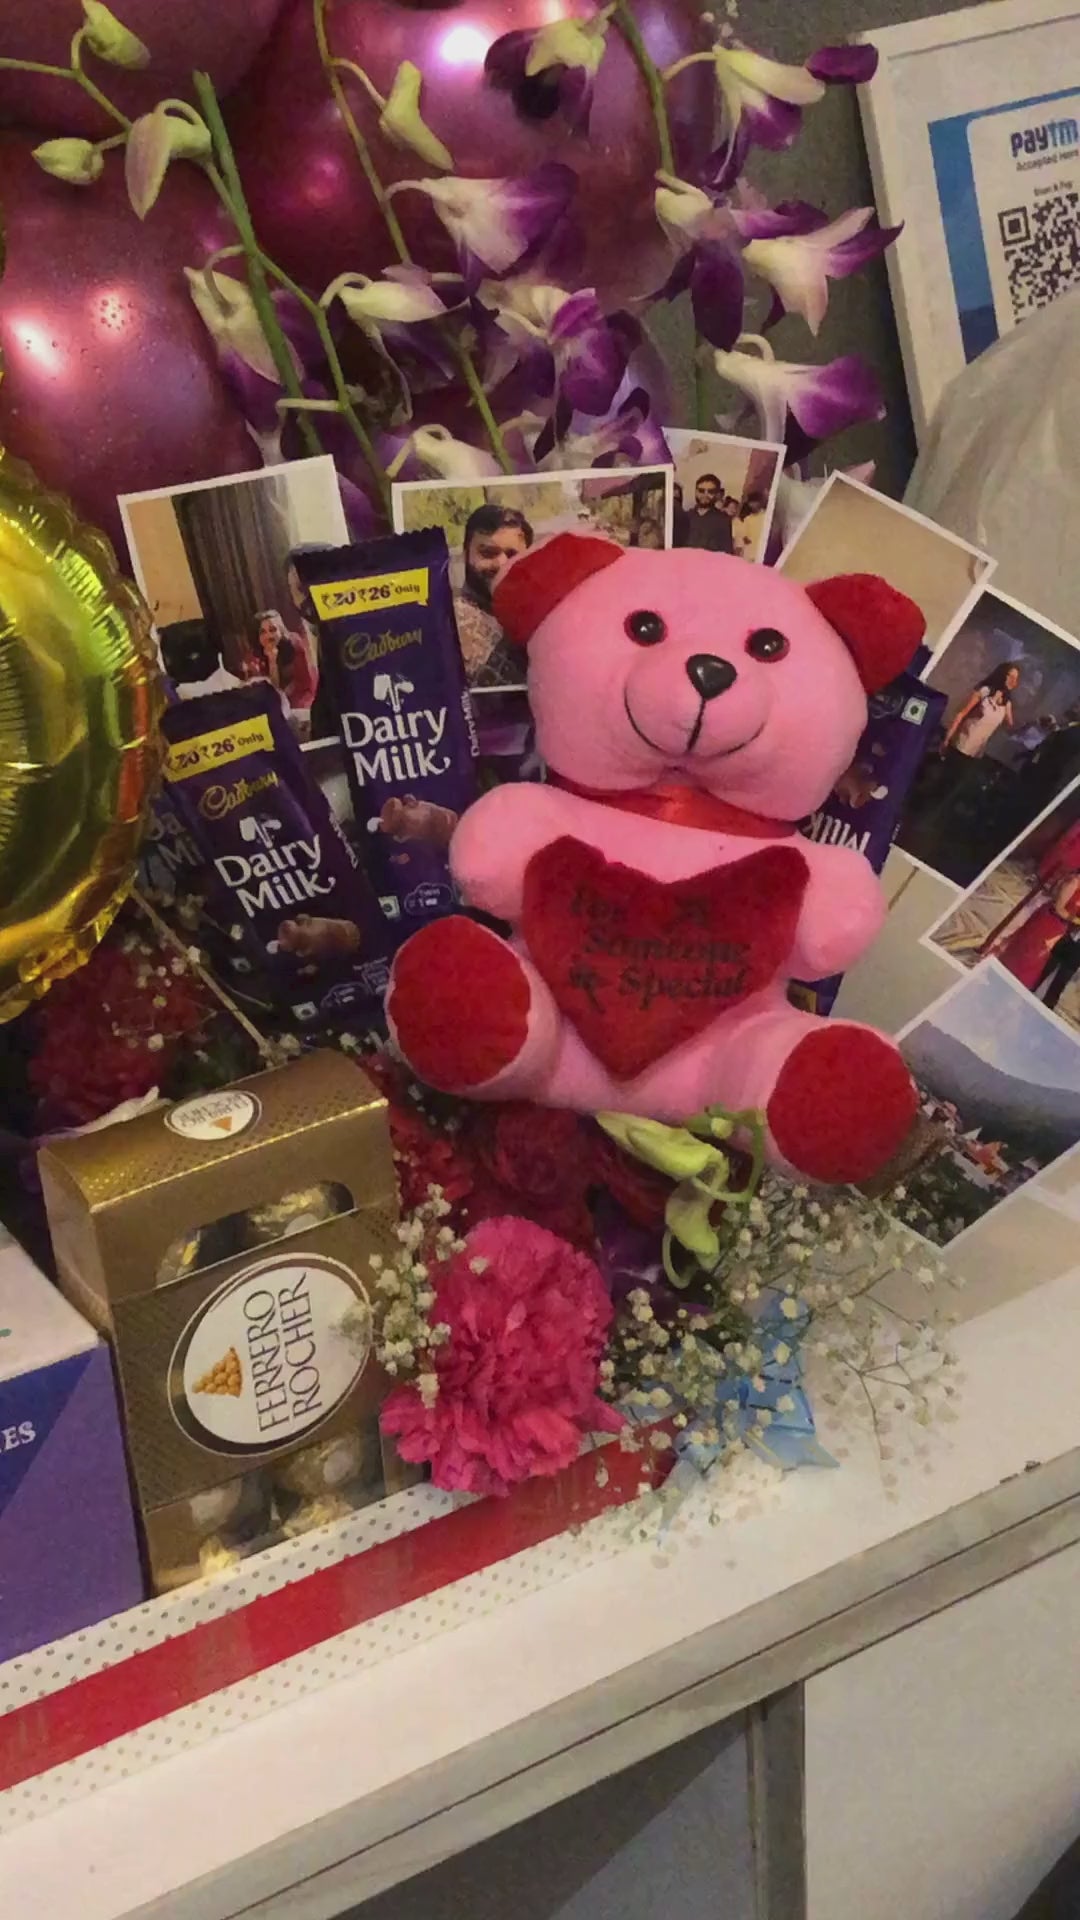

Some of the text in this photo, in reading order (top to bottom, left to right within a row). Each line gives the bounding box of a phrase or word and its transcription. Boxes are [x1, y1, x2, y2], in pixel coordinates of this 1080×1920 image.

[342, 627, 423, 680] Cadbury
[341, 706, 447, 748] Dairy
[352, 742, 451, 787] Milk
[213, 833, 321, 887] Dairy
[235, 869, 336, 918] Milk
[243, 1290, 289, 1432] FERRERO
[278, 1271, 323, 1419] ROCHER
[0, 1421, 37, 1452] ES
